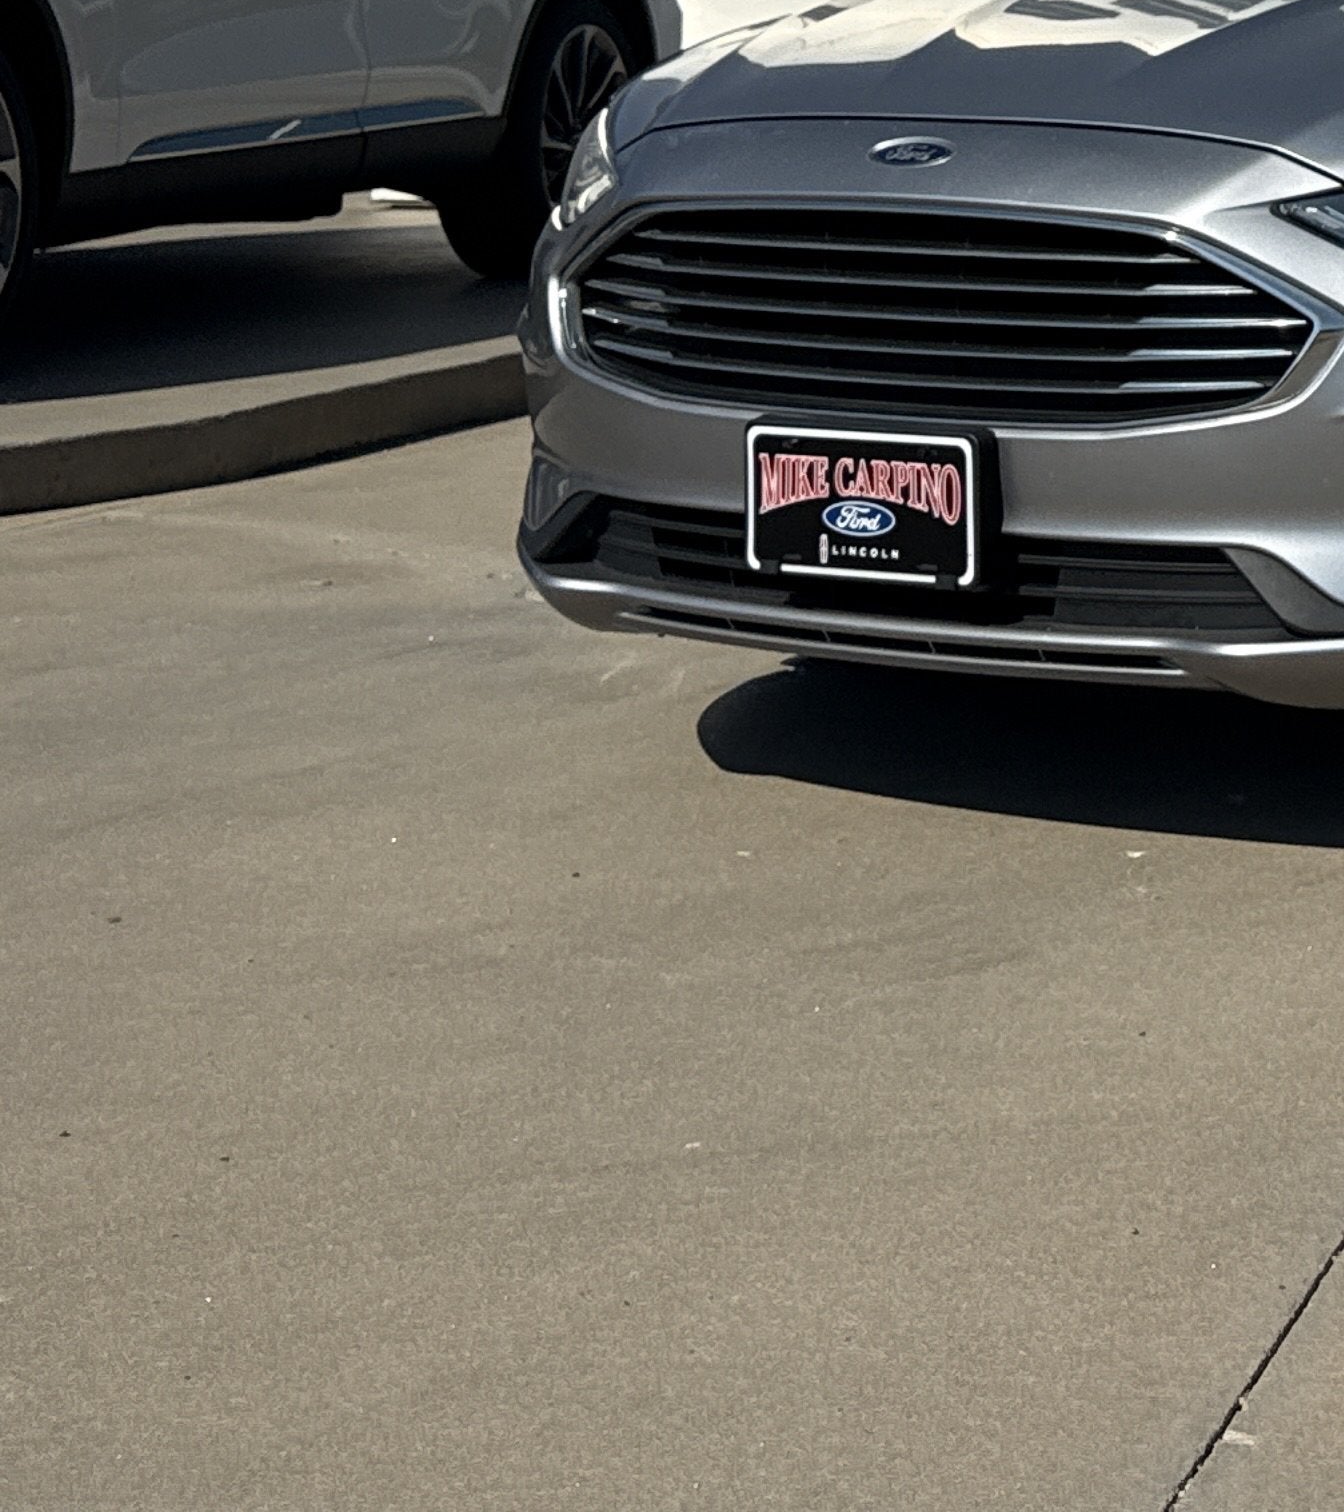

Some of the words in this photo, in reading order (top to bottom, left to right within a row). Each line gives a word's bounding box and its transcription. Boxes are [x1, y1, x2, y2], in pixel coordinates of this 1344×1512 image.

[758, 452, 830, 515] MIKE
[834, 457, 962, 526] CARPINO
[836, 505, 882, 531] Ford
[832, 545, 900, 560] LINCOLN
